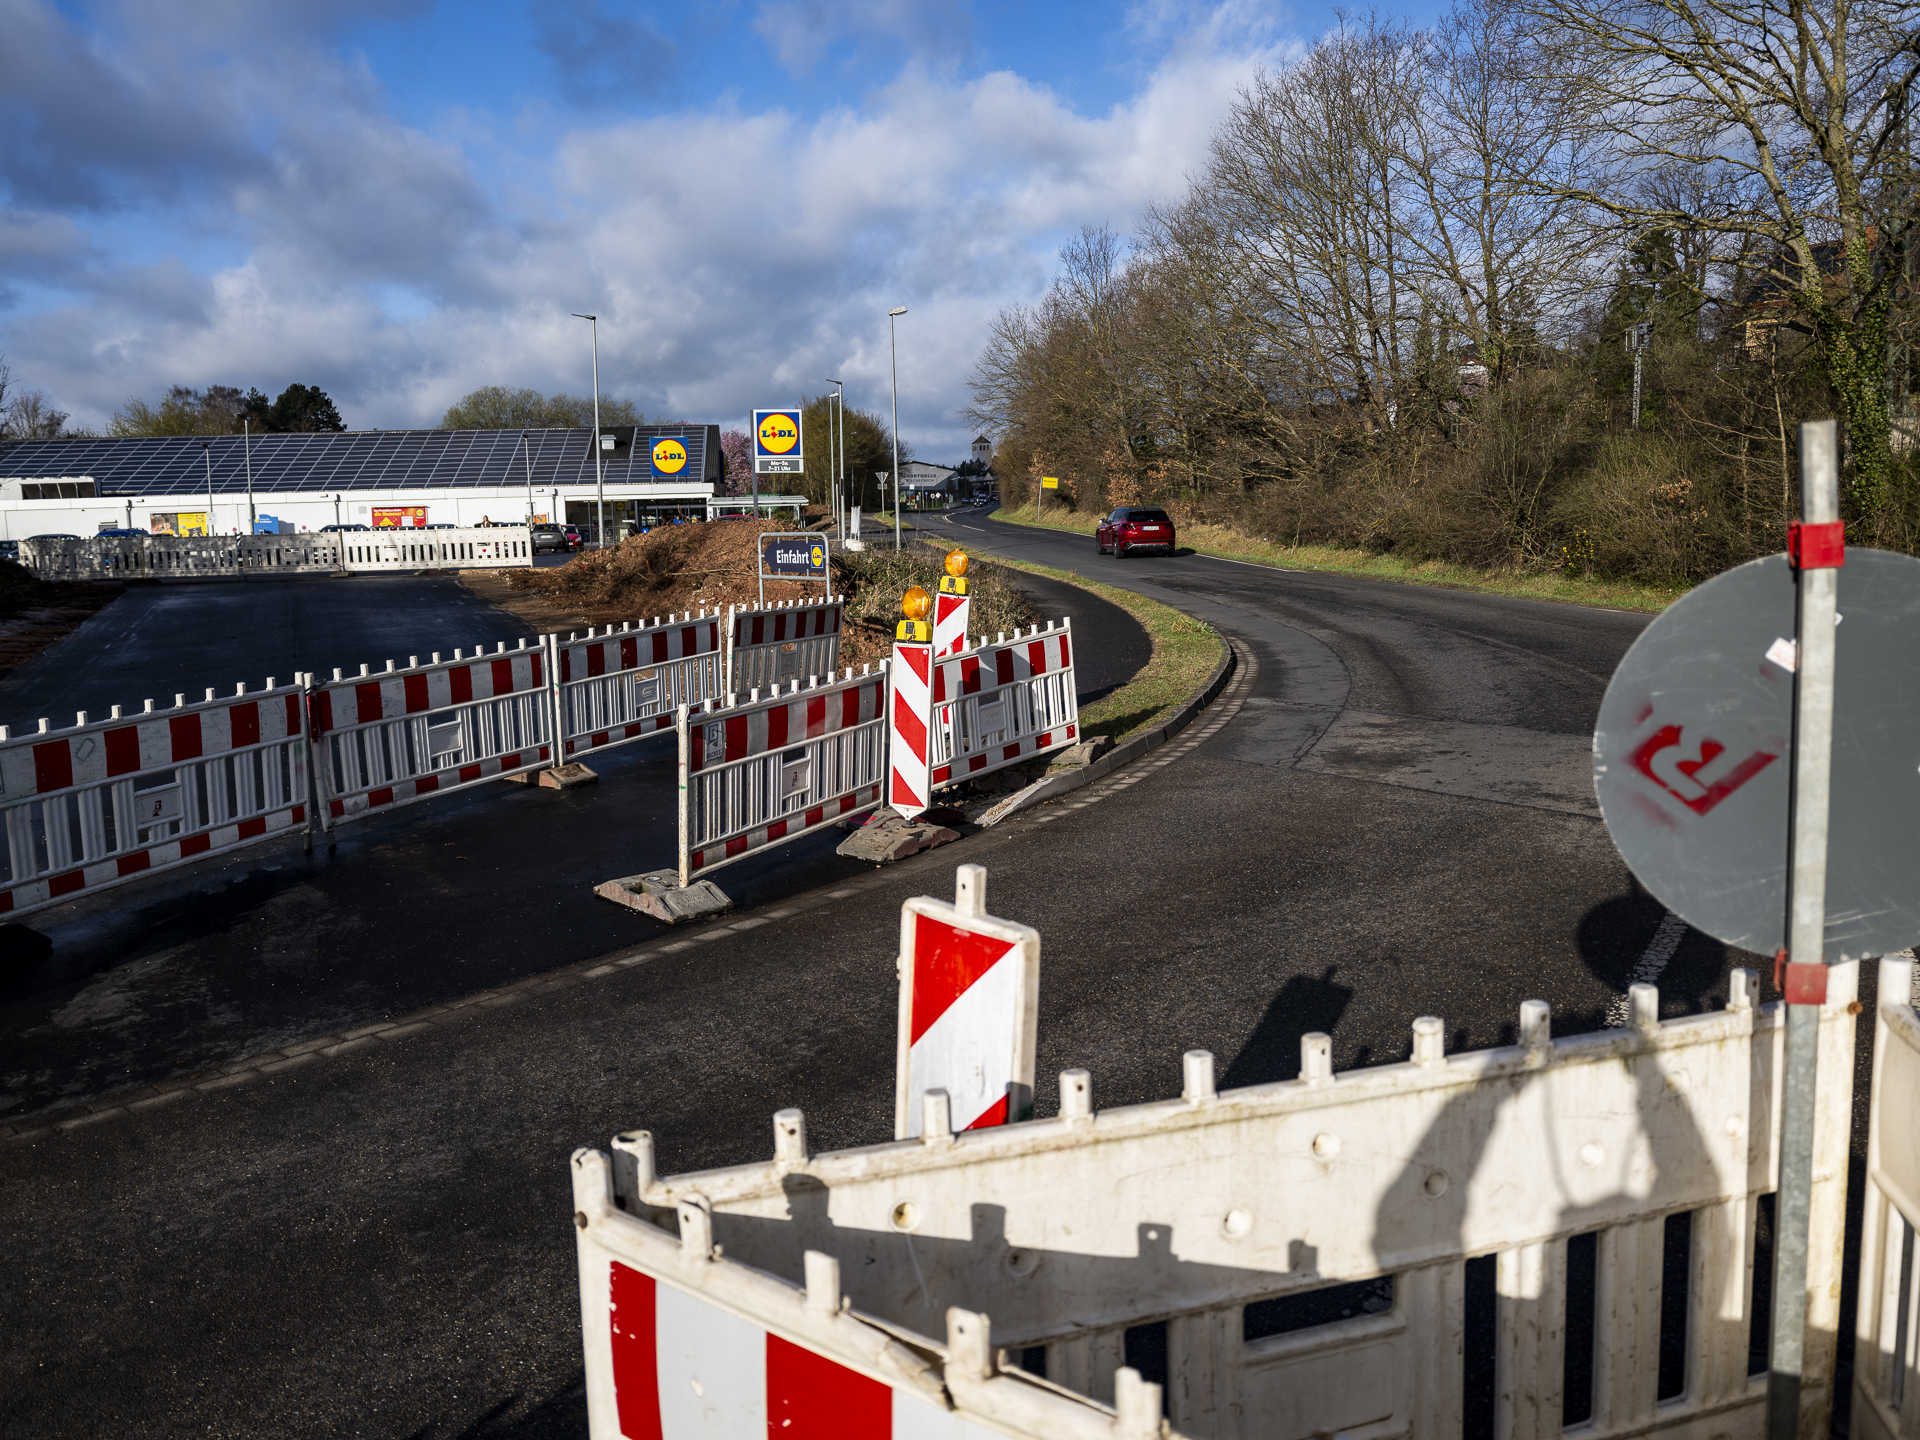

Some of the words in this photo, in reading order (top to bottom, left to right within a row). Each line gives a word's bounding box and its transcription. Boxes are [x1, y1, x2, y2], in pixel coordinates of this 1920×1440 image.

[762, 426, 795, 439] LIDL
[655, 450, 684, 461] LIDL
[776, 548, 810, 565] Einfahrt
